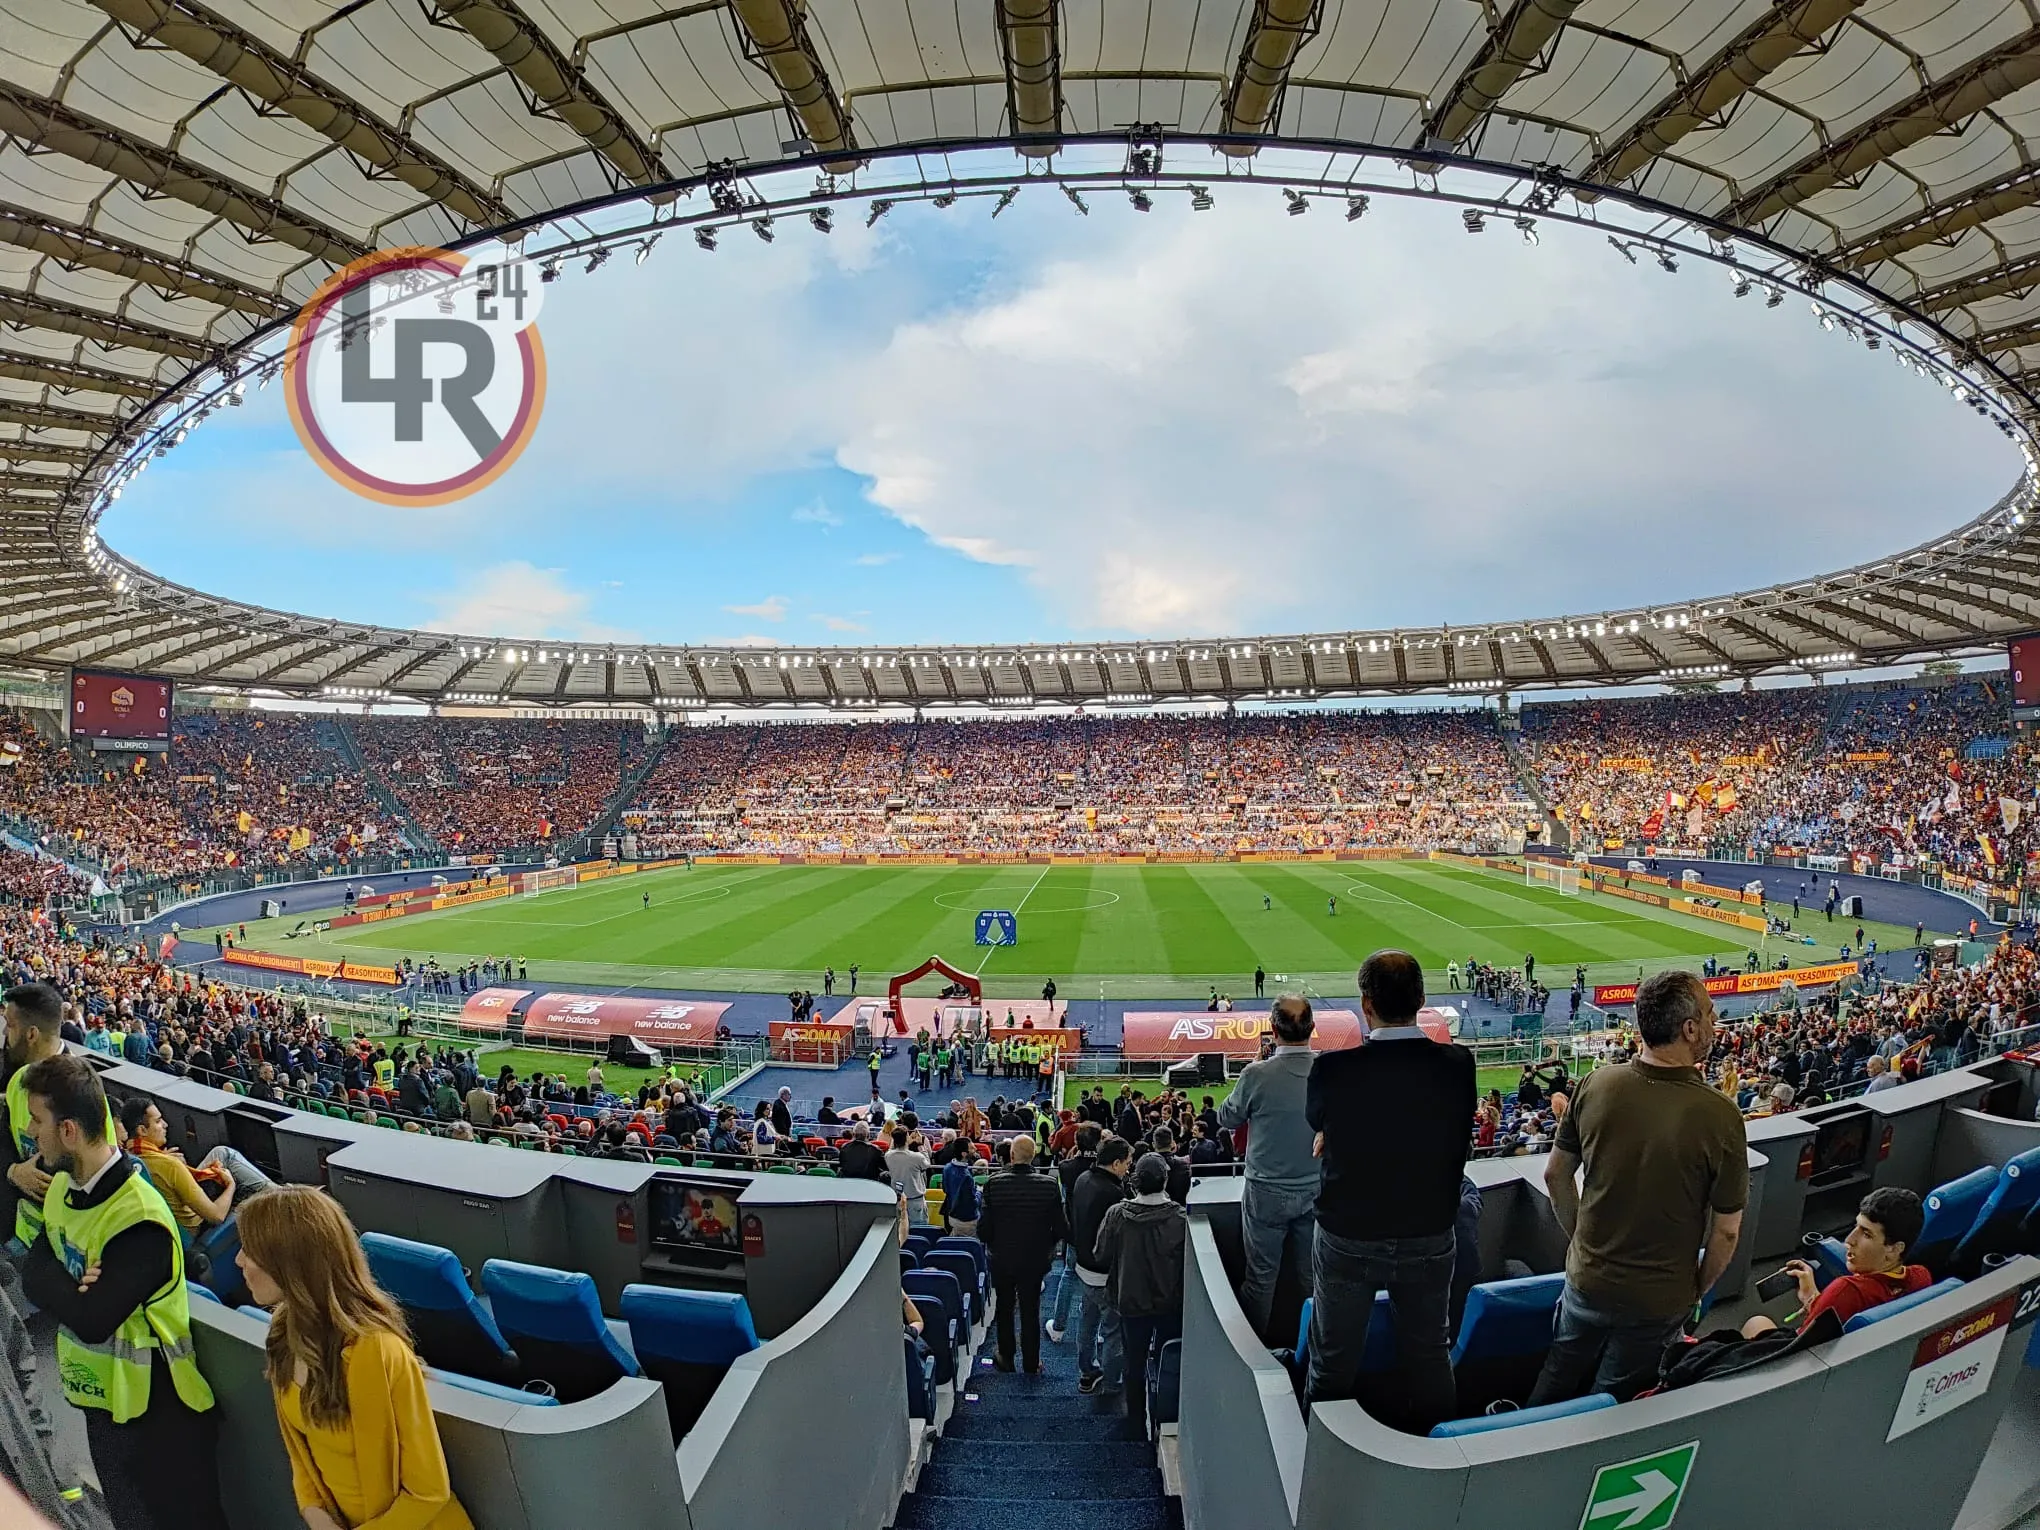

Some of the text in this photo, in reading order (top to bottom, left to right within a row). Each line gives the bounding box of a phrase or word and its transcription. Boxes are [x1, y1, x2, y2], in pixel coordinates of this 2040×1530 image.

[2015, 670, 2022, 683] 0
[76, 700, 85, 713] 0
[159, 707, 167, 719] 0
[114, 741, 149, 750] OLIMPICO
[1600, 759, 1651, 767] TESTACCIO
[1691, 905, 1699, 914] DA
[1709, 909, 1715, 917] A
[1715, 911, 1741, 924] PARTITA
[478, 997, 504, 1008] ASR
[547, 1014, 601, 1025] new balance
[635, 1019, 692, 1030] new balance
[1934, 1362, 1981, 1395] Cimas
